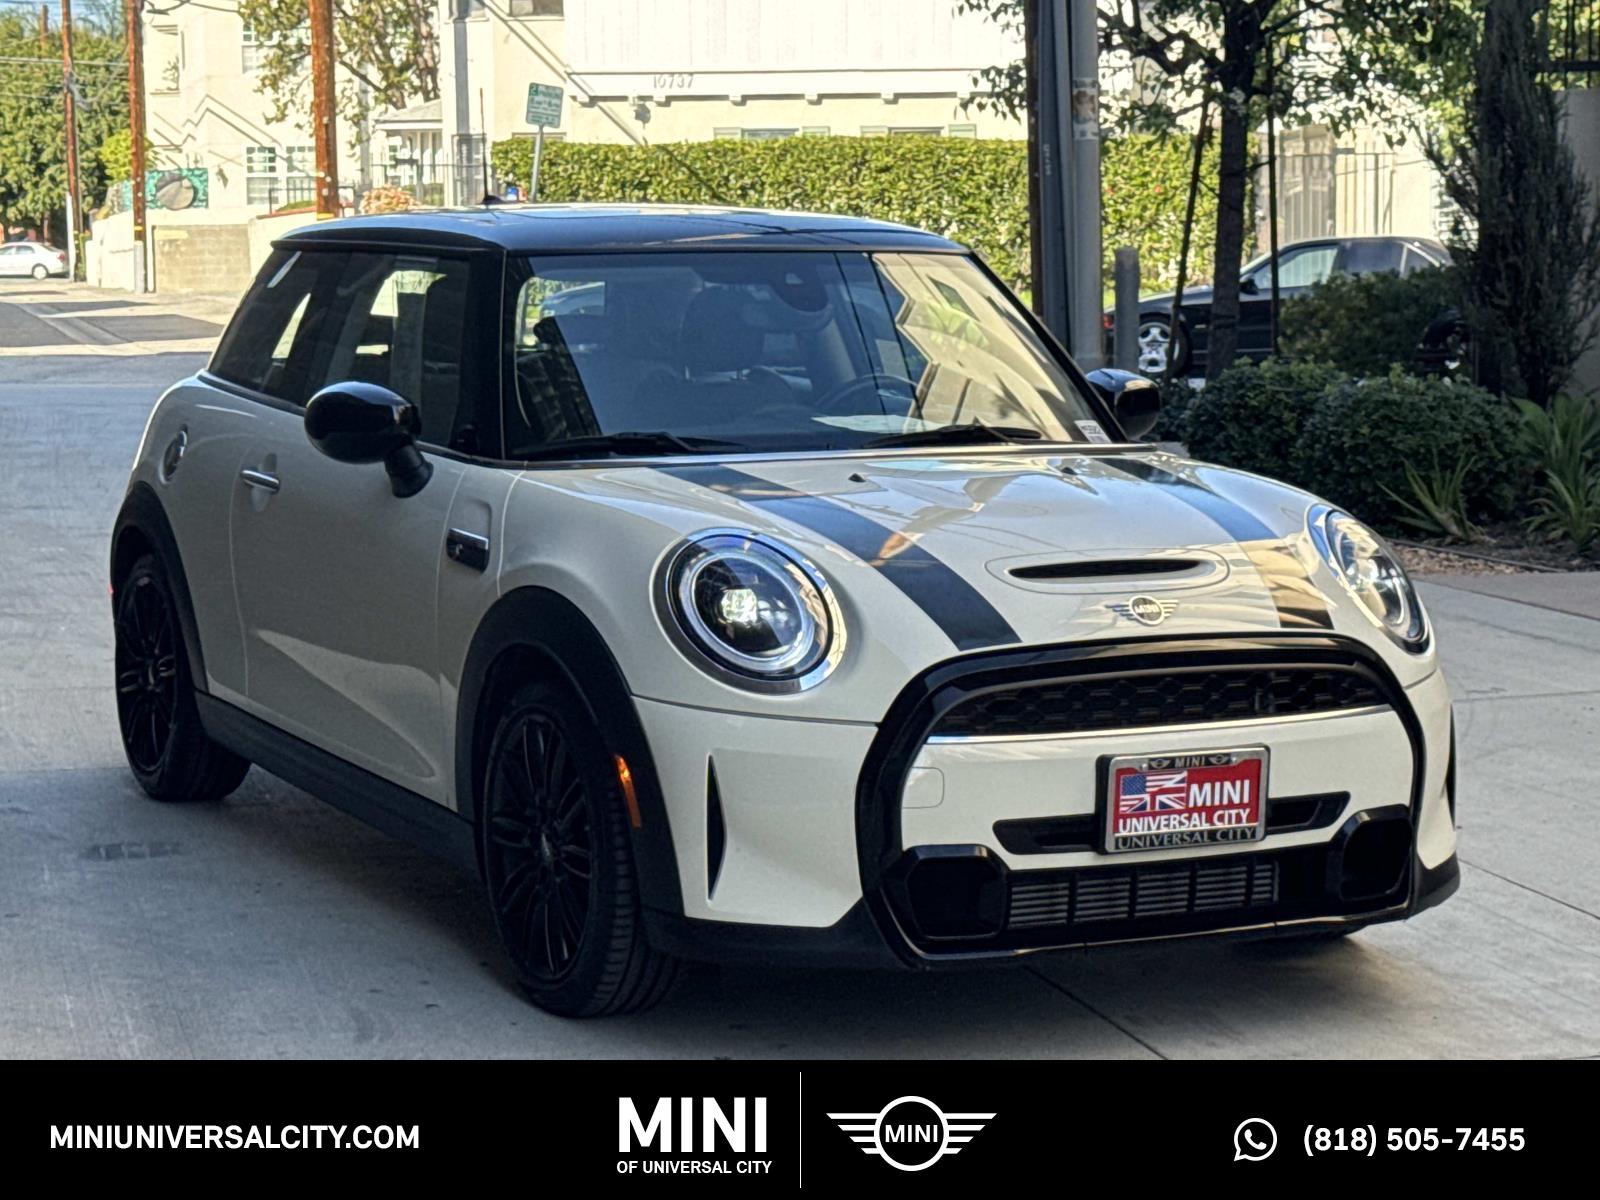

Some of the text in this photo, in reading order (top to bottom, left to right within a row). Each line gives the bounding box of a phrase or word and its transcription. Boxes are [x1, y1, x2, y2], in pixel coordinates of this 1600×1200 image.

[653, 74, 694, 88] 10737
[1175, 756, 1206, 768] MINI
[1188, 779, 1251, 808] MINI
[1118, 808, 1251, 833] UNIVERSAL CITY
[1118, 827, 1257, 849] UNIVERSAL CITY
